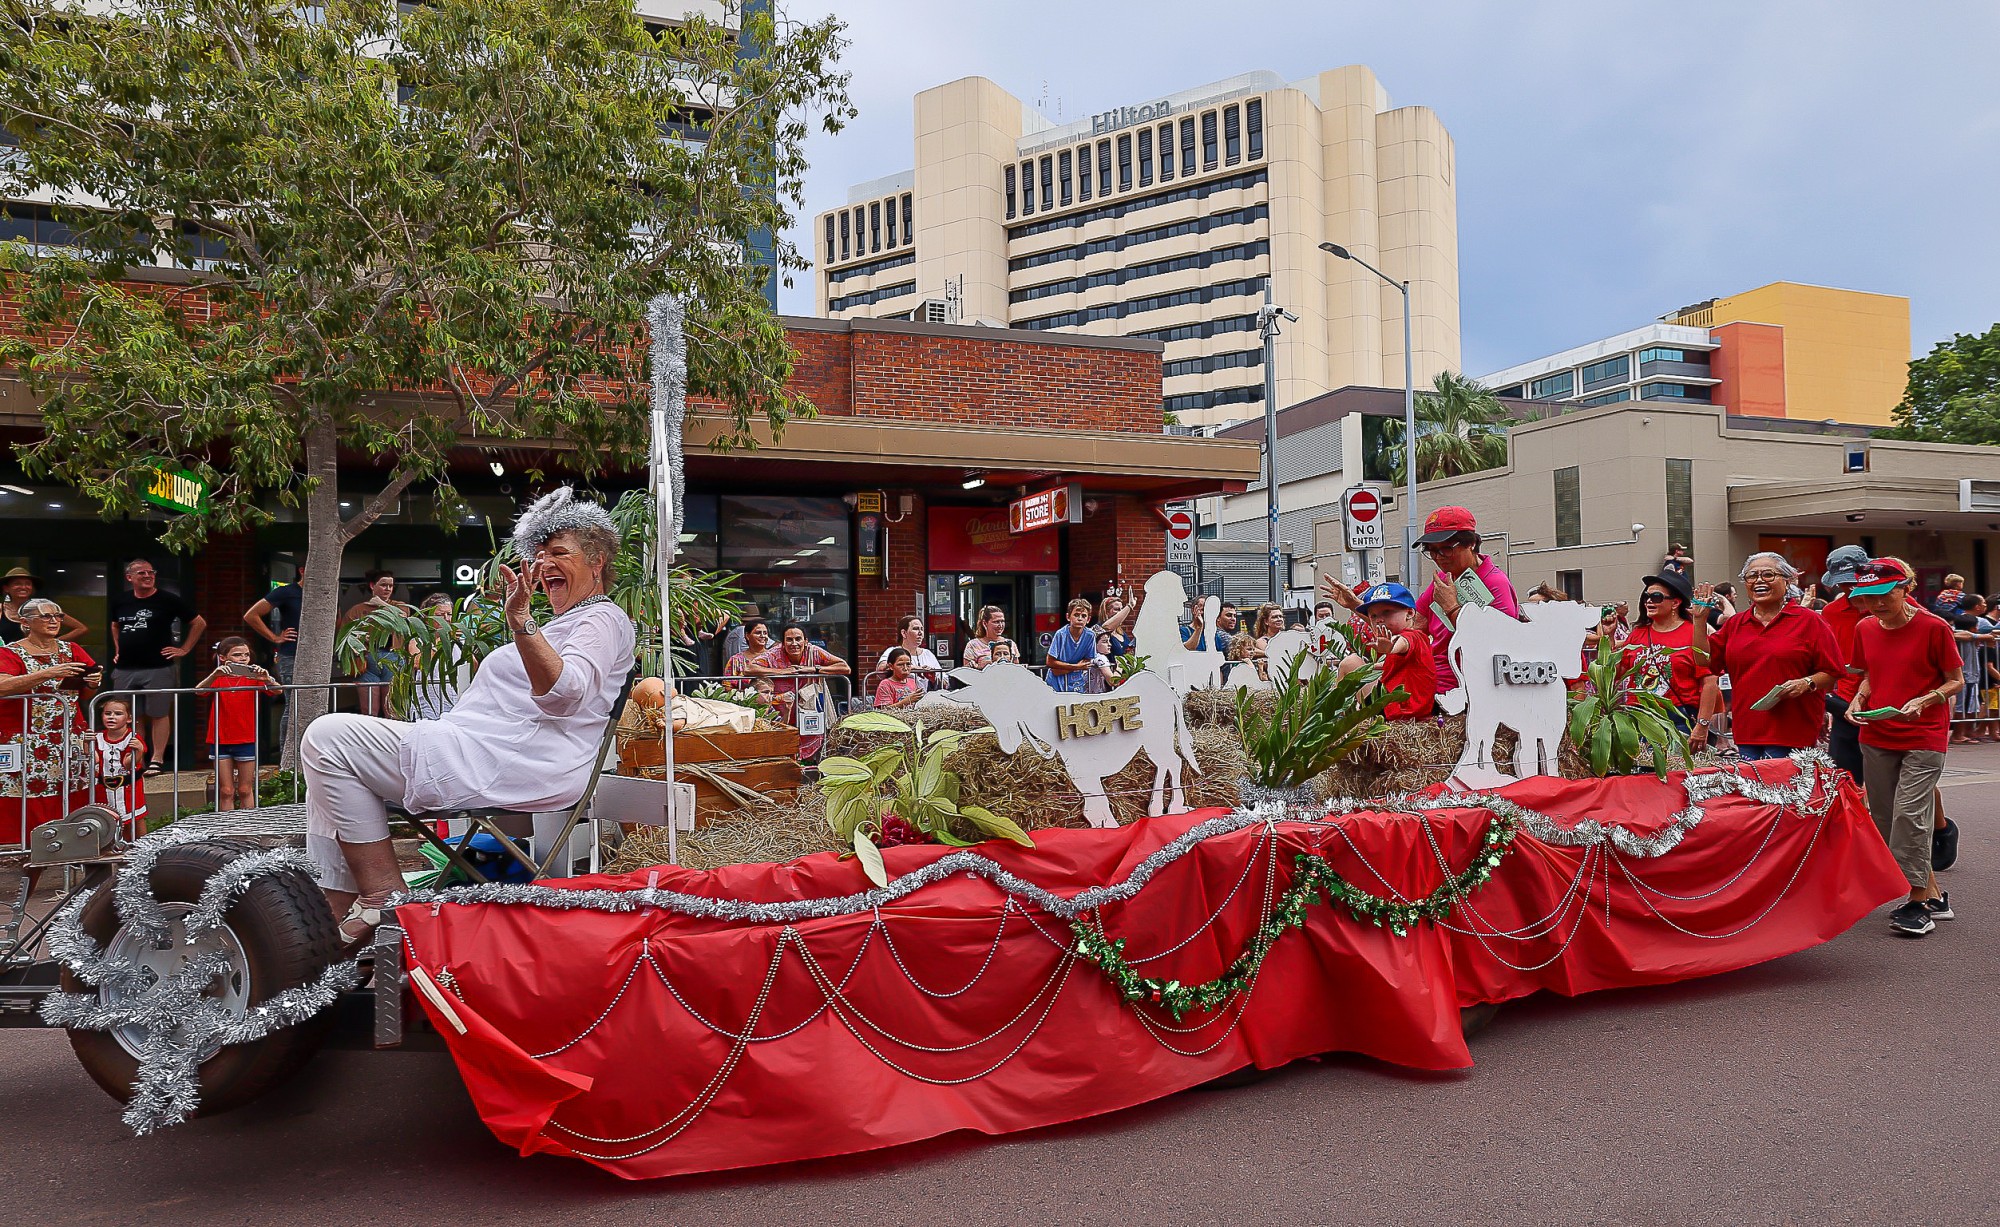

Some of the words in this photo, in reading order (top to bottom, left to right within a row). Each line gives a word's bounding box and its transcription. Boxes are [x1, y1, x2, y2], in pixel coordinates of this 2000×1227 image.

[1091, 100, 1170, 135] Hilton
[1025, 503, 1049, 521] STORE
[1356, 525, 1375, 535] NO
[1173, 542, 1189, 551] NO
[1352, 537, 1380, 545] ENTRY
[1170, 552, 1192, 560] ENTRY
[1493, 655, 1557, 686] Peace
[1056, 696, 1143, 739] HOPE
